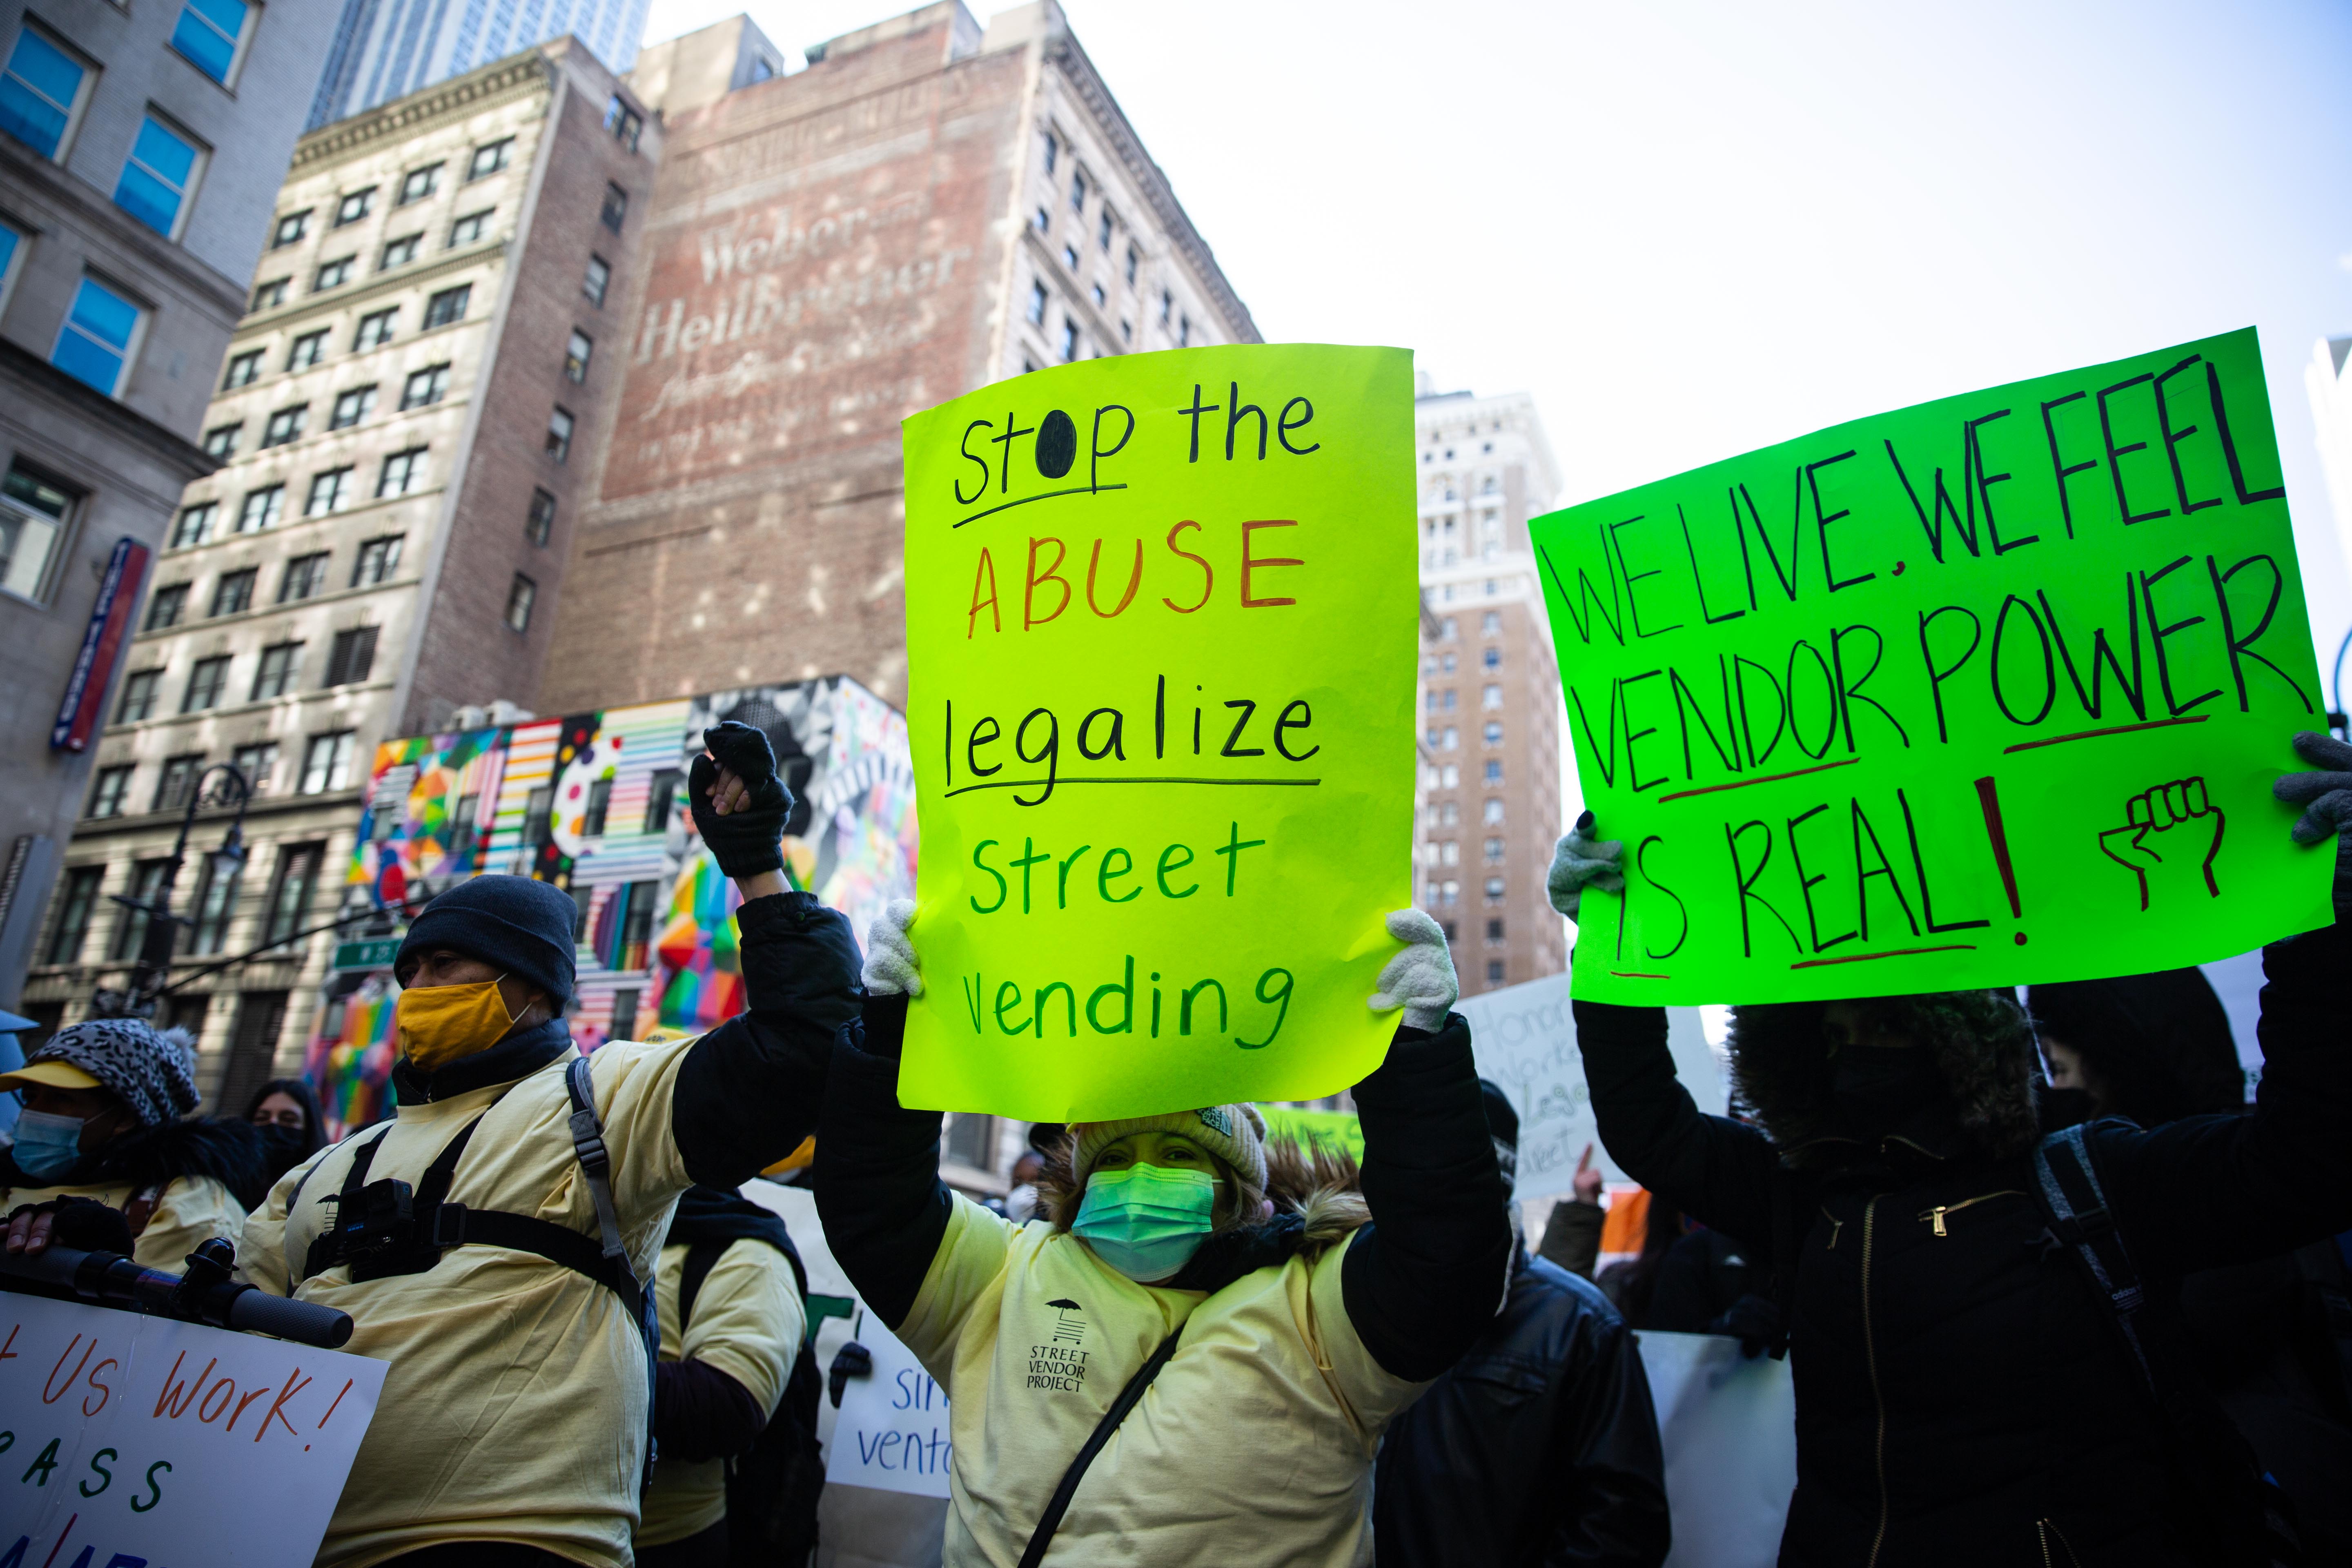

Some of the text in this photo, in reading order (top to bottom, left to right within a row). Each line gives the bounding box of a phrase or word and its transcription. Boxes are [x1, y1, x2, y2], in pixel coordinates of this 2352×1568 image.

[953, 405, 1135, 505] Stop
[1178, 382, 1321, 462] the
[1540, 515, 1684, 646] WE
[1884, 409, 2040, 563] WE
[2040, 354, 2286, 539] FEEL
[967, 520, 1305, 639] ABUSE
[1570, 554, 2314, 792] VENDOR POWER
[945, 675, 1321, 806] legalize
[971, 822, 1266, 914] Street
[1617, 775, 2029, 960] IS REAL!
[1027, 1375, 1083, 1392] PROJECT
[1029, 1361, 1085, 1380] VENDOR
[1031, 1346, 1090, 1364] STREET
